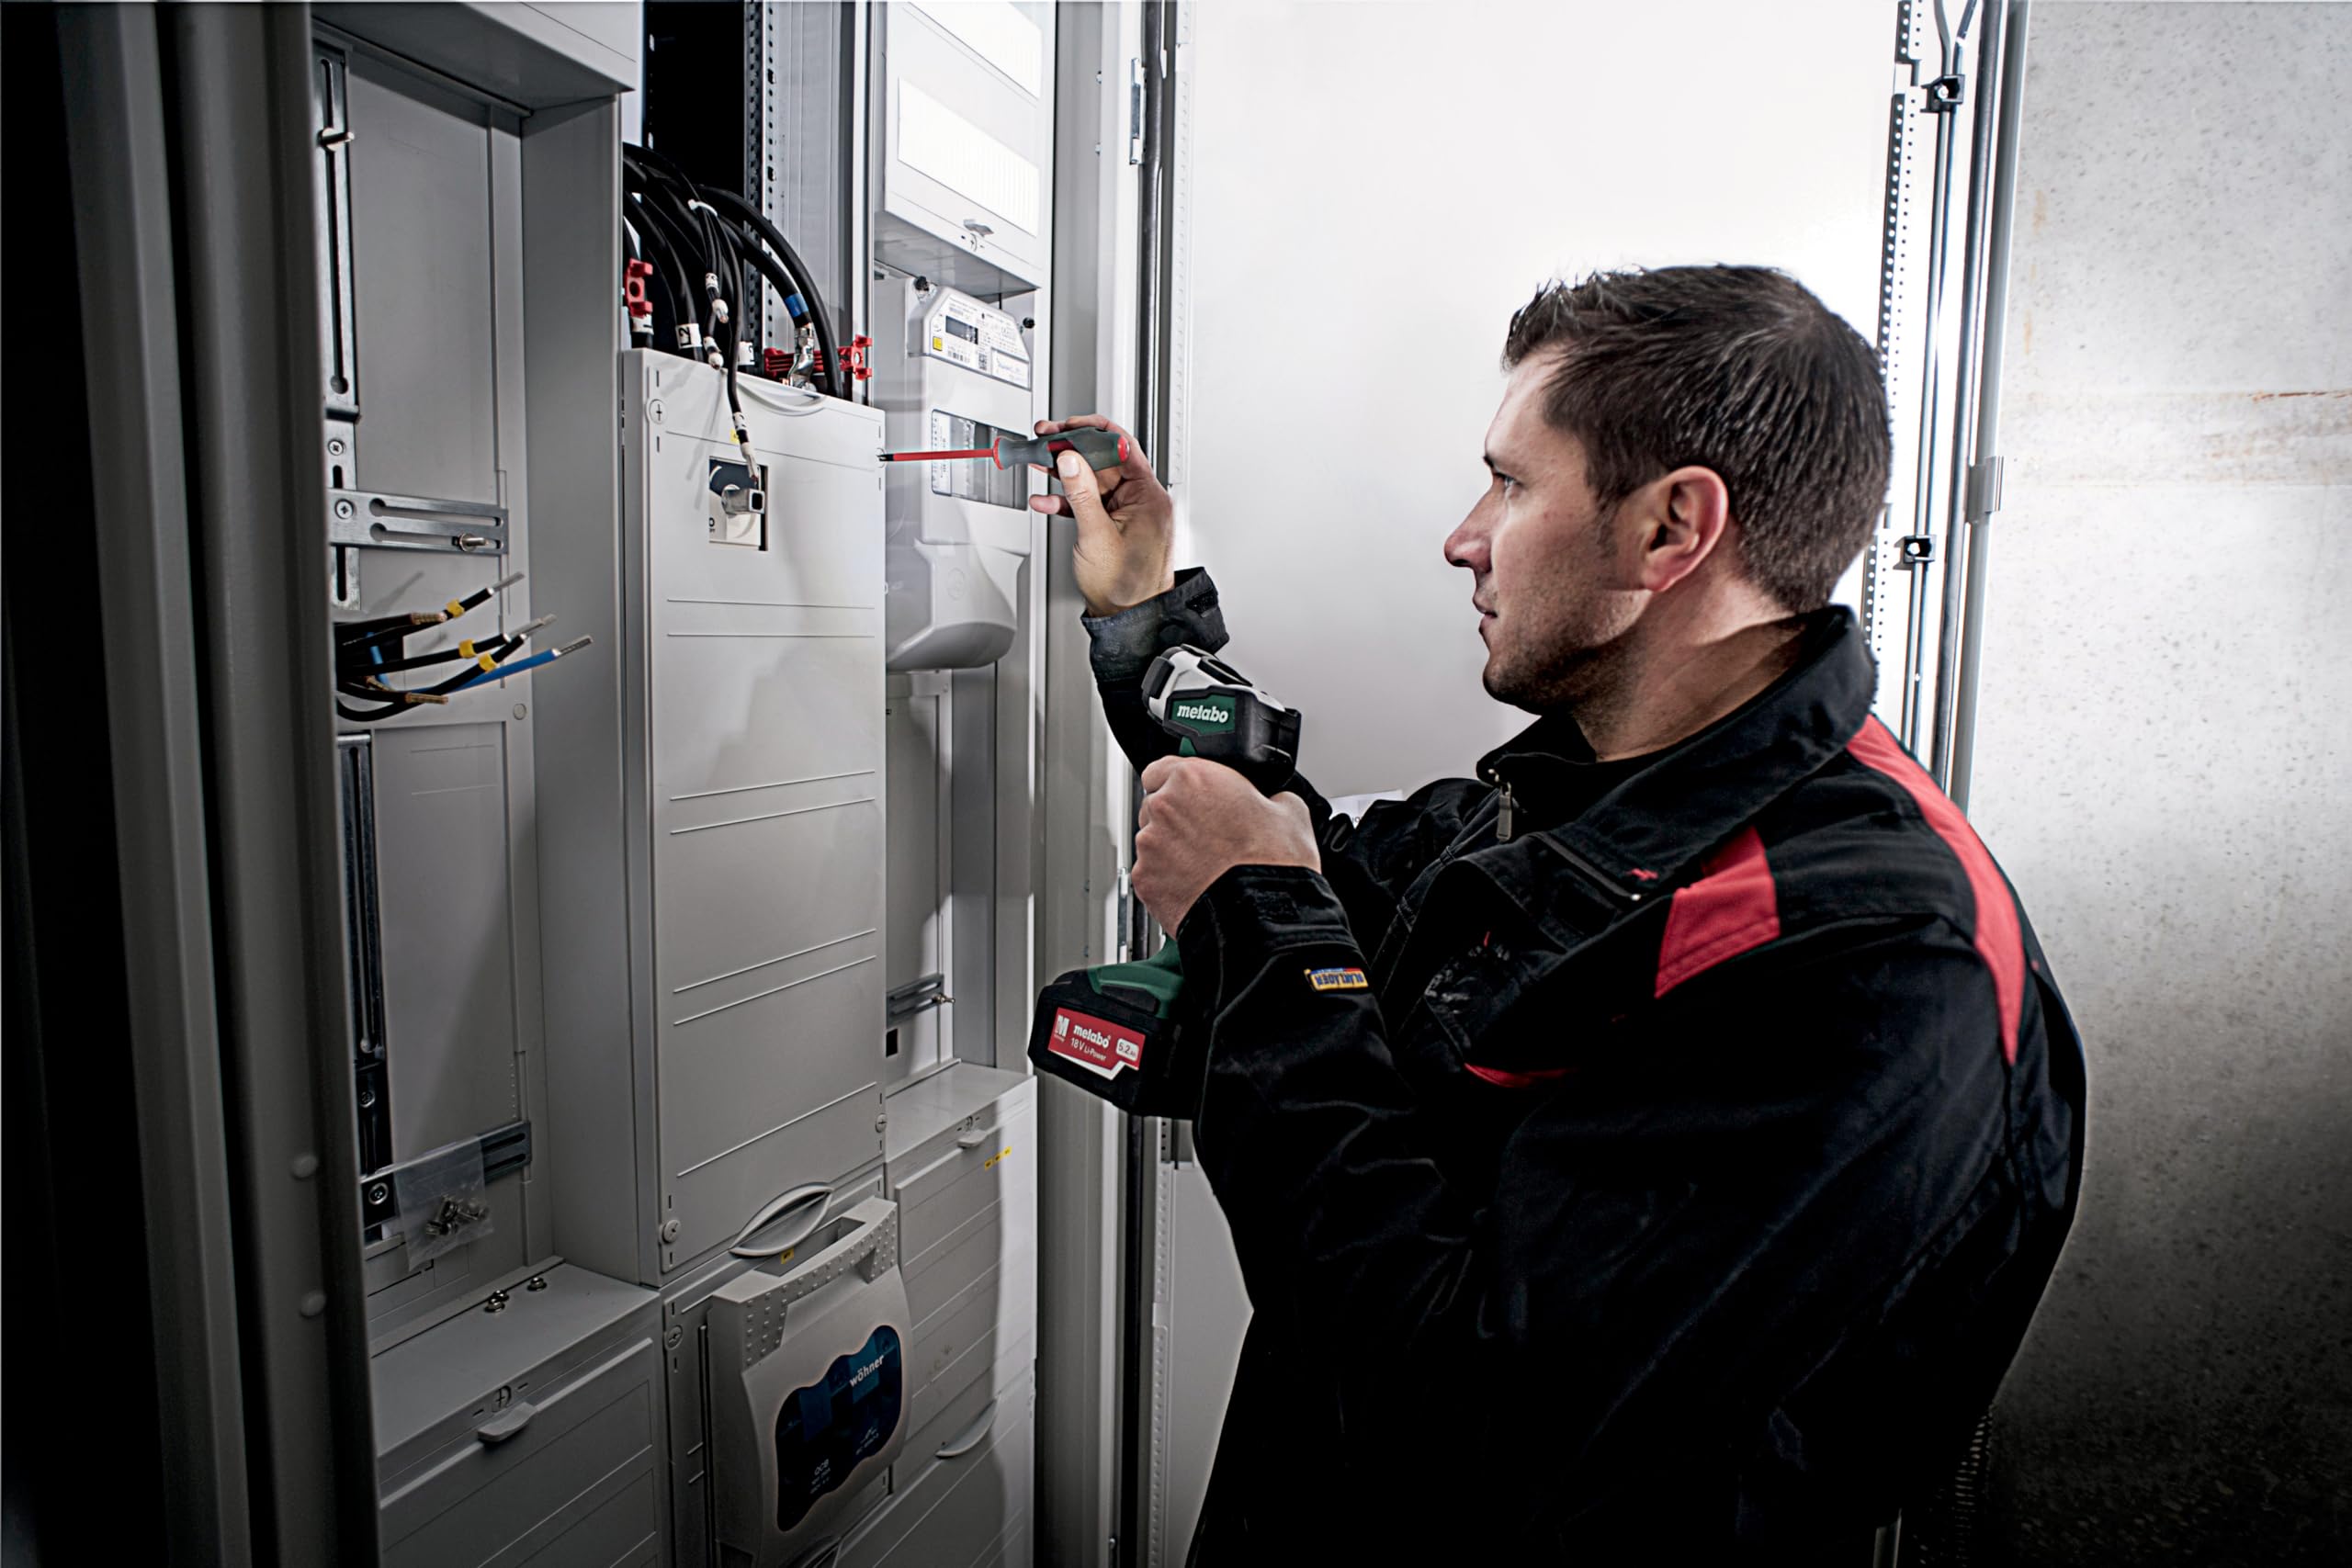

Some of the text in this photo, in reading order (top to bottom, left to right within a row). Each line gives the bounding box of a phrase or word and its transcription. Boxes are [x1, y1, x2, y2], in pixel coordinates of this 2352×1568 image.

[1177, 705, 1229, 724] metabo
[1073, 1024, 1109, 1048] metabo
[850, 1355, 884, 1387] wöhner
